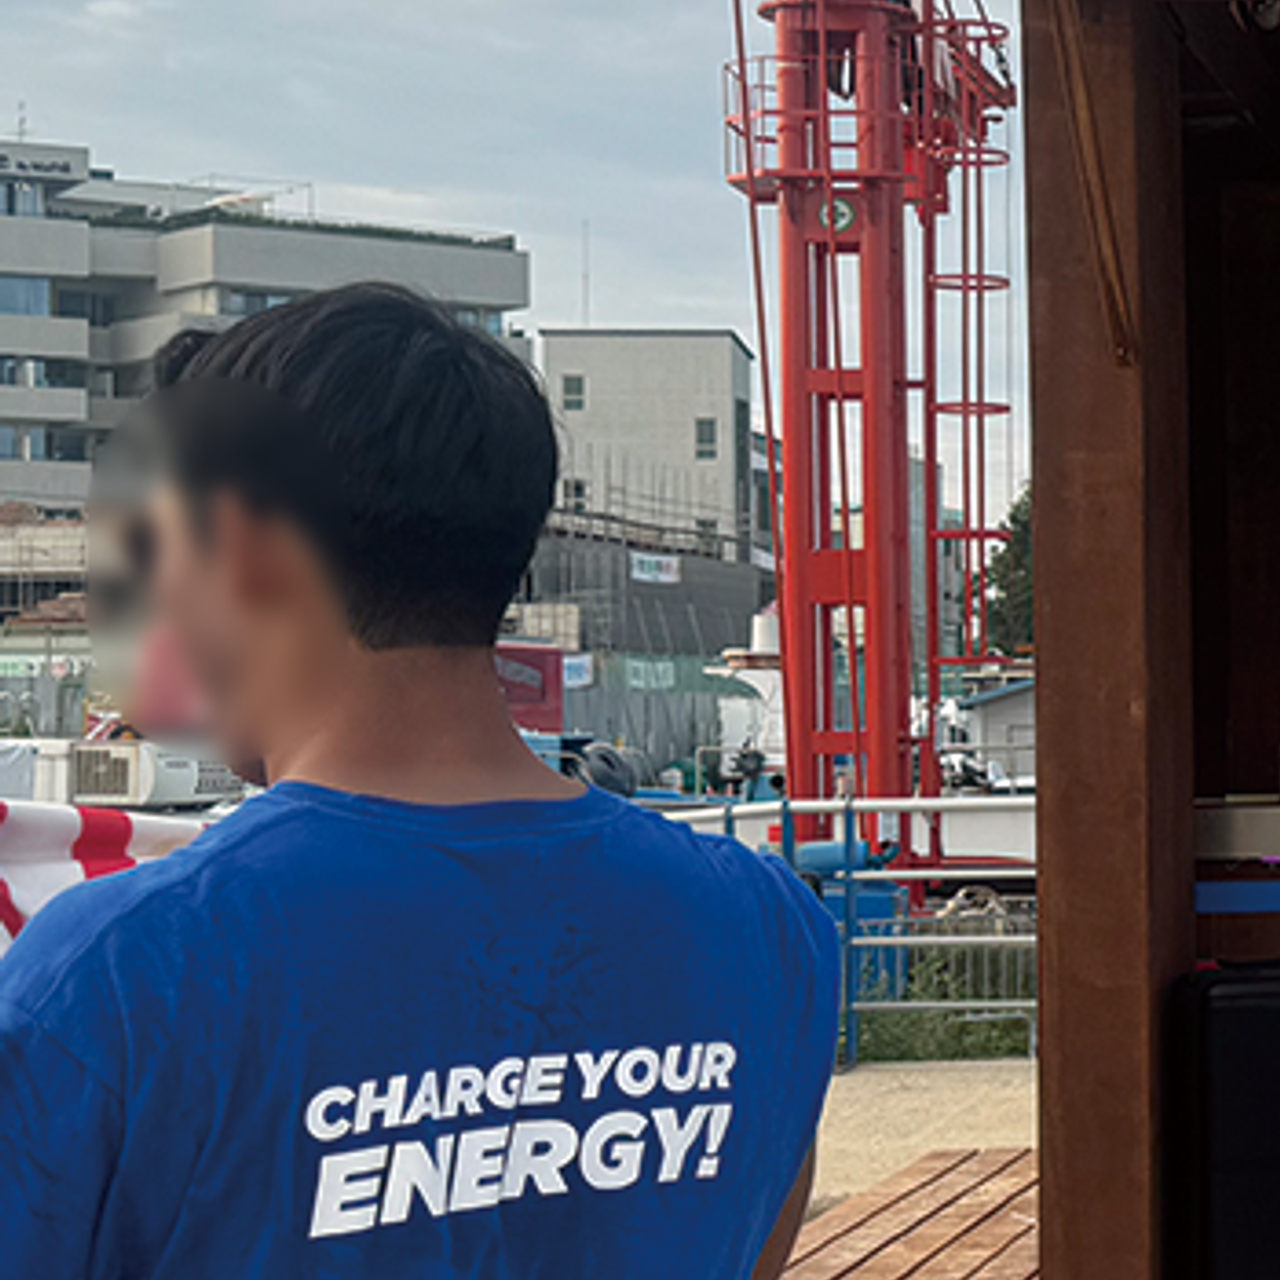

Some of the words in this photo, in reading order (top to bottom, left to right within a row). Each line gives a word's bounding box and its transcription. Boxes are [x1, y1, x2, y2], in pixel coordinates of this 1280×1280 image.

[305, 1054, 567, 1141] CHARGE
[575, 1042, 737, 1100] YOUR
[308, 1104, 733, 1239] ENERGY!
